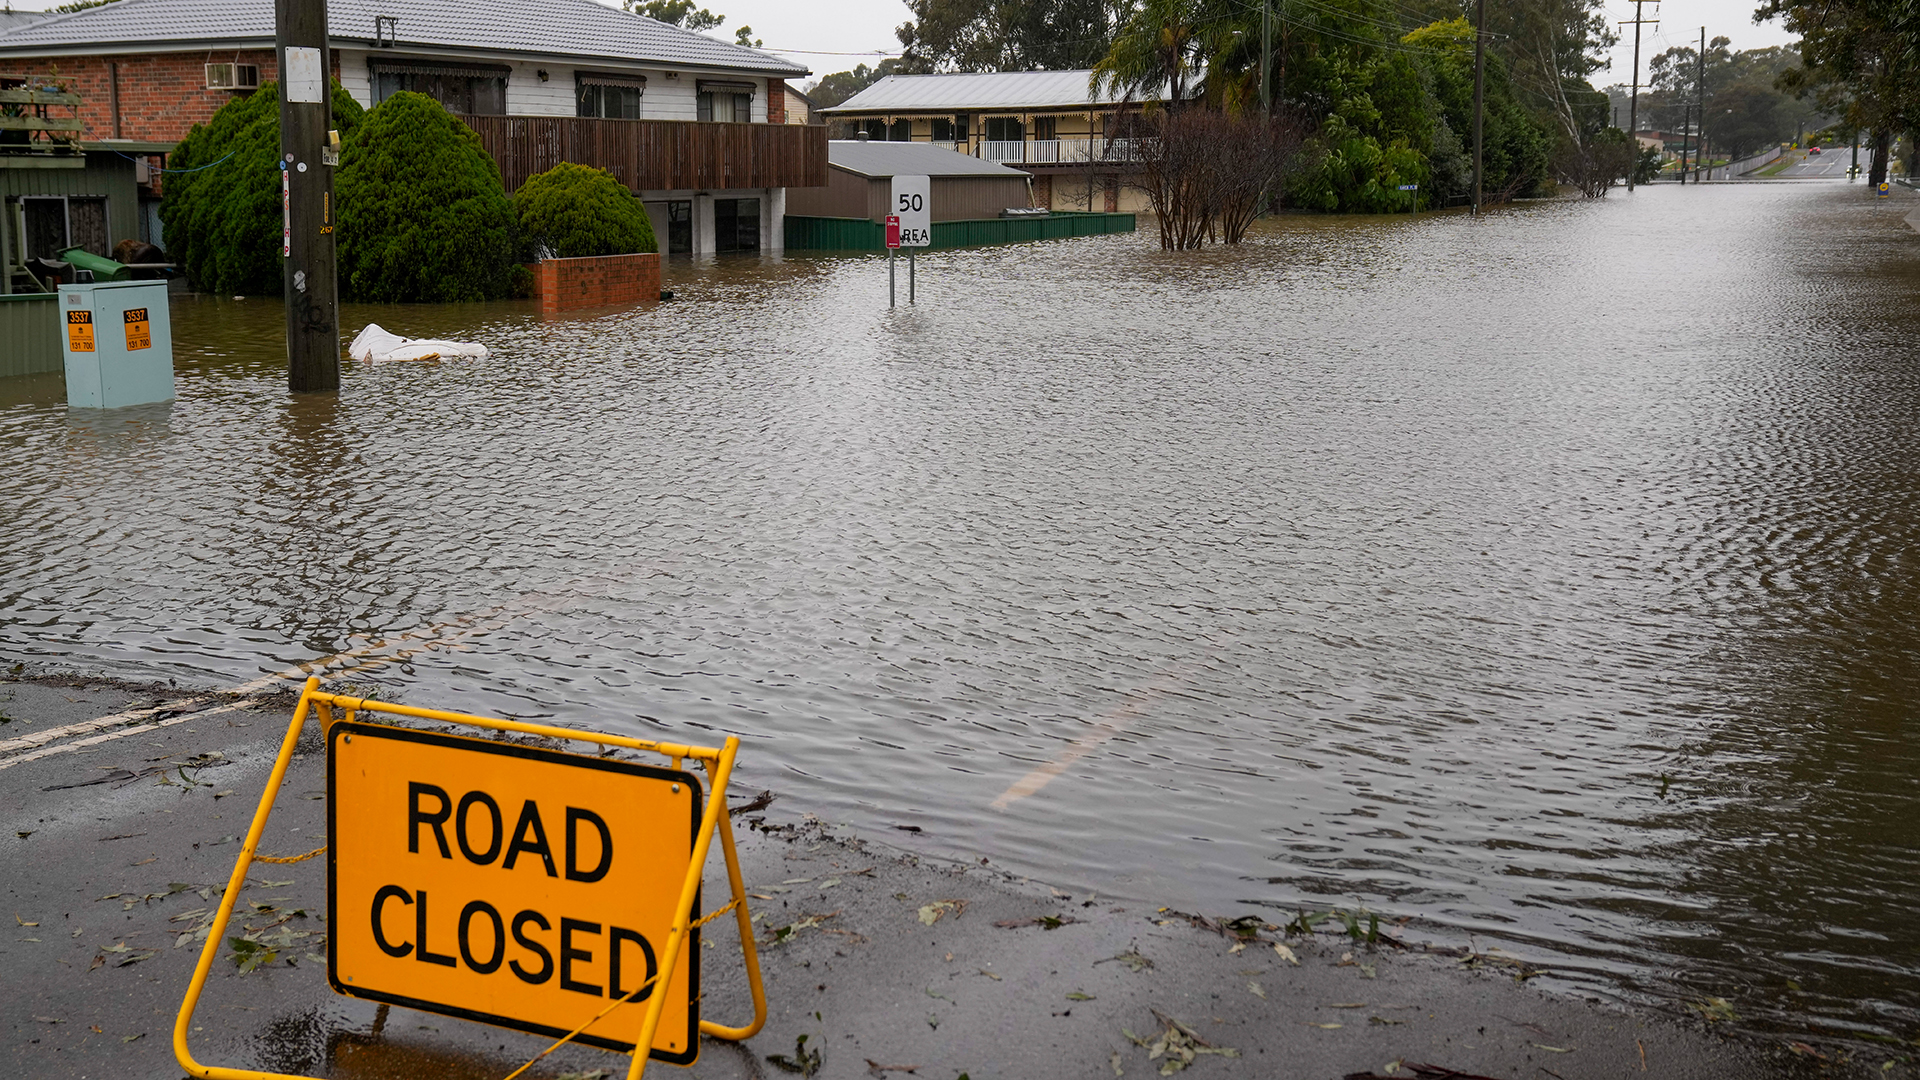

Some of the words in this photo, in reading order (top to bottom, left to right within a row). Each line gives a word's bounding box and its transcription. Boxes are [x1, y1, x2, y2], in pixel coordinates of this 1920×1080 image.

[900, 194, 923, 212] 50
[320, 226, 333, 234] 267
[900, 229, 929, 241] REA
[69, 312, 89, 323] 3537
[126, 310, 145, 322] 3537
[71, 342, 81, 350] 131
[83, 342, 93, 350] 700
[128, 340, 138, 348] 131
[139, 338, 150, 347] 700
[408, 780, 613, 883] ROAD
[370, 884, 657, 1003] CLOSED
